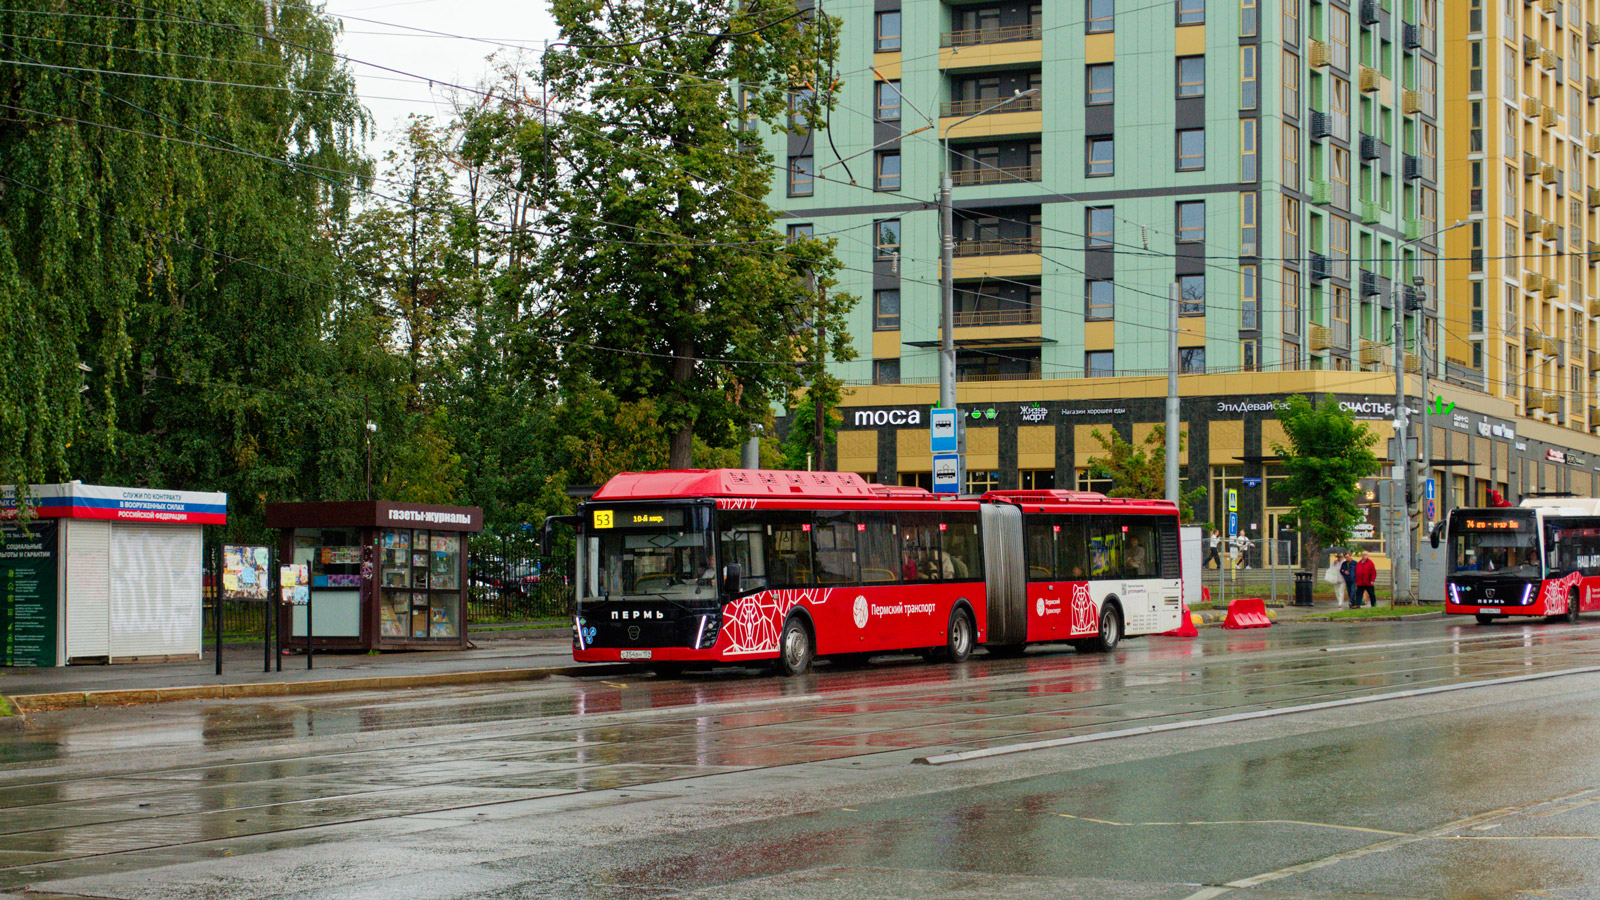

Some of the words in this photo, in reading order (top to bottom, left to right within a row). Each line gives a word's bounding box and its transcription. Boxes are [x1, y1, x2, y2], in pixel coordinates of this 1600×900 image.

[1020, 406, 1048, 415] Жизнь
[1339, 401, 1391, 413] СЧАСТЬЕ
[1023, 413, 1046, 423] март
[124, 501, 166, 510] ВООРУЖЕННЫХ
[166, 503, 185, 511] СИЛАХ
[118, 510, 155, 519] РОССИЙСКОЙ
[154, 513, 188, 521] ФЕДЕРАЦИИ
[596, 513, 610, 526] 53
[6, 543, 43, 551] СОЦИАЛЬНЫЕ
[611, 610, 664, 620] ПЕРМЬ
[871, 601, 904, 619] Пермский
[903, 603, 936, 617] транспорт
